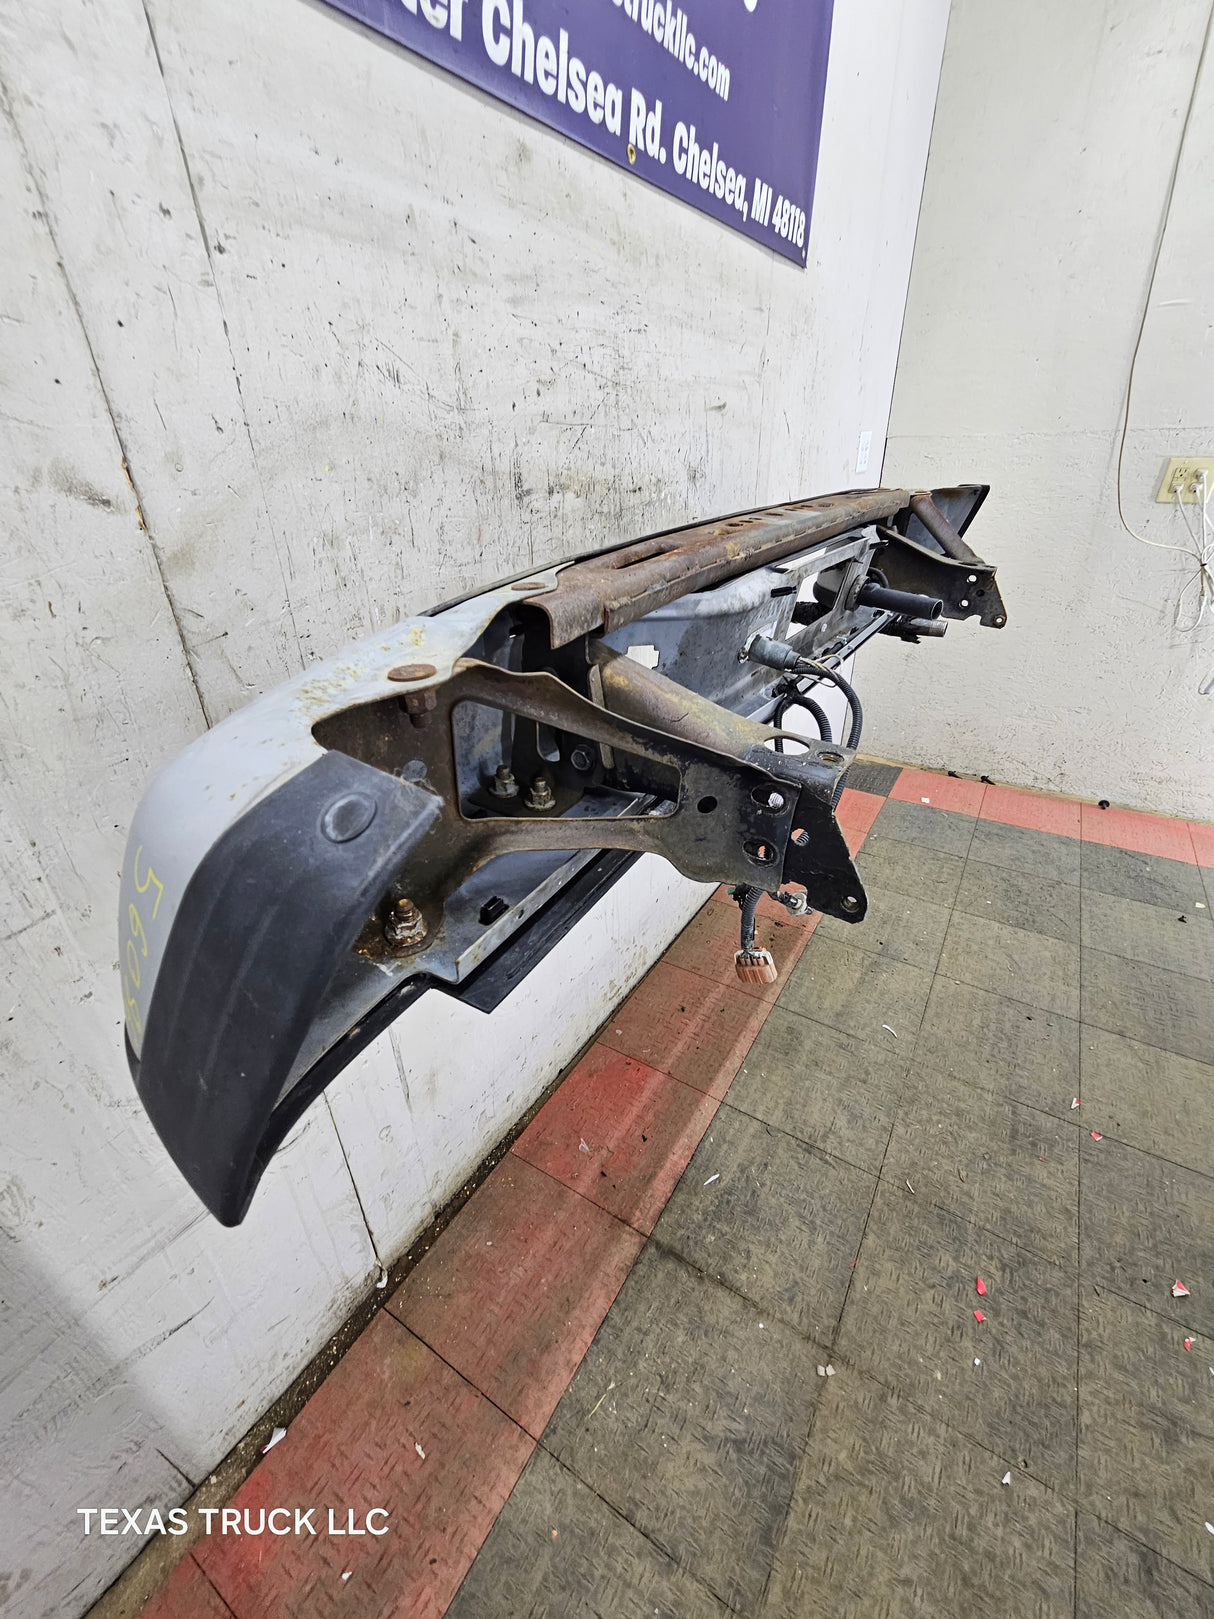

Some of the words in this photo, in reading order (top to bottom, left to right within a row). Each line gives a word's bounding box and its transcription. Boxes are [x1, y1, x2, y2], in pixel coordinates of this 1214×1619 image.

[481, 0, 623, 137] Chelsea
[629, 86, 667, 164] Rd.
[672, 121, 749, 223] Chelsea,
[751, 177, 773, 227] MI
[771, 195, 806, 248] 48118
